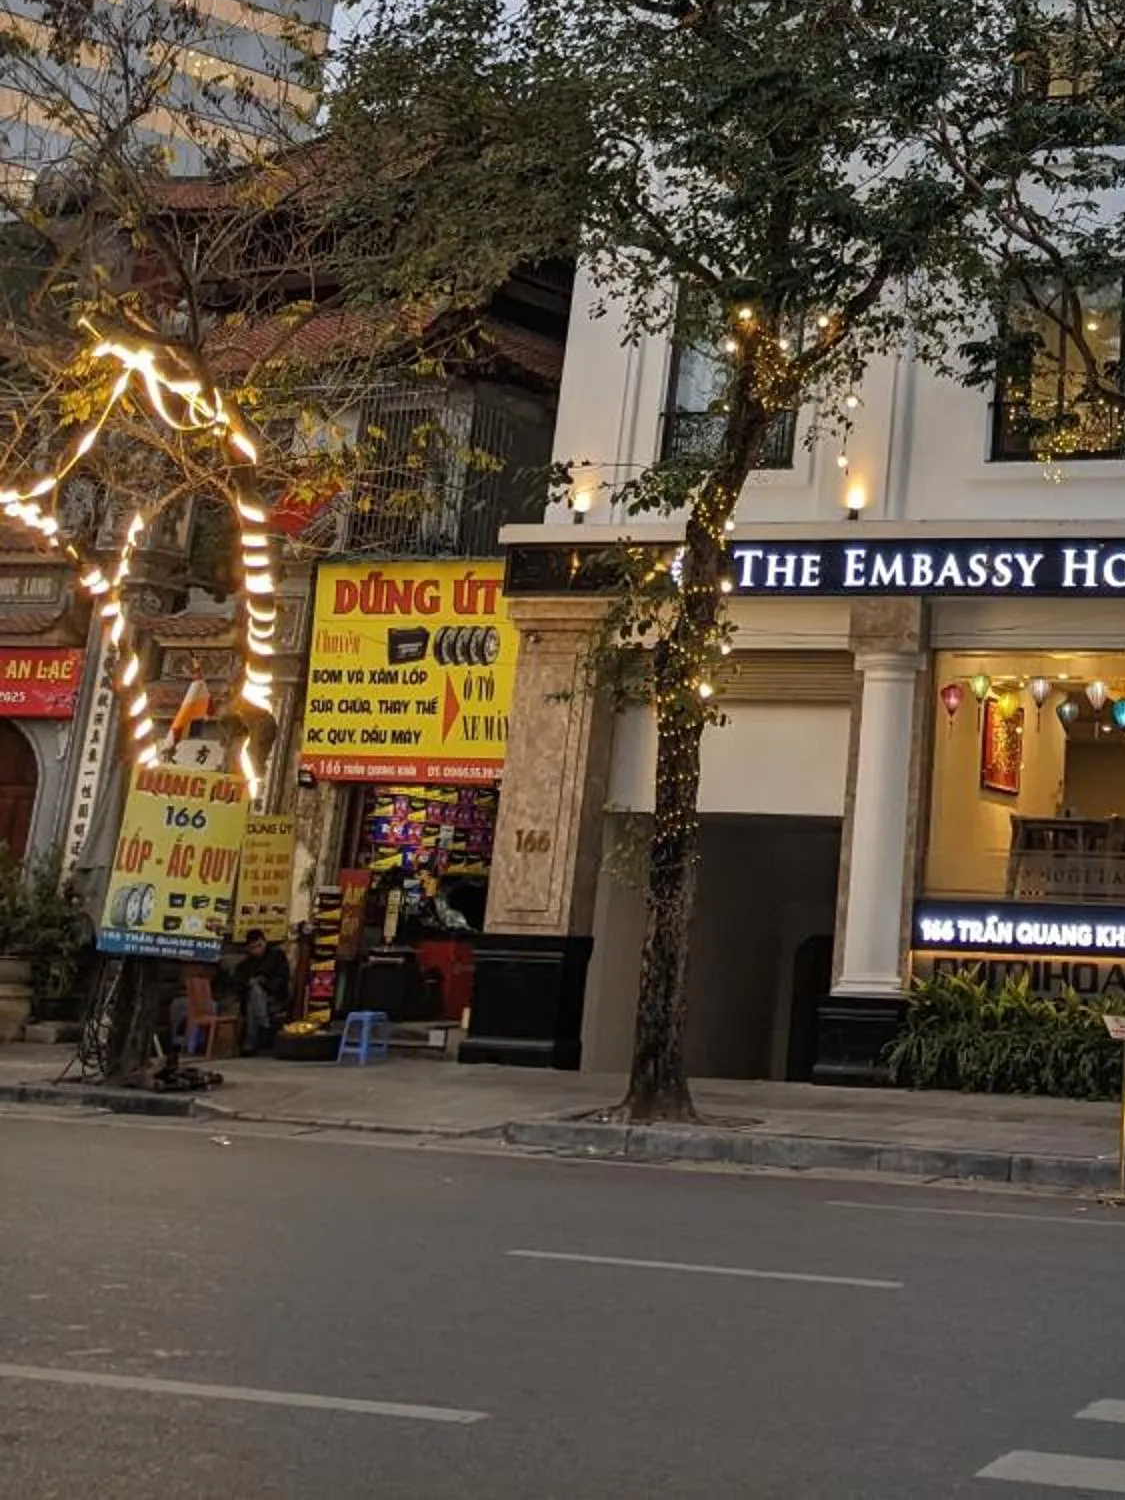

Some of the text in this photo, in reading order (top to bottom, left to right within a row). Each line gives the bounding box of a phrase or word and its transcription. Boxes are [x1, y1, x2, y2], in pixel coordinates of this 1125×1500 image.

[733, 549, 821, 588] THE
[843, 547, 1044, 588] EMBASSY
[453, 570, 504, 615] ÚT
[6, 659, 32, 679] AN
[320, 760, 341, 775] 166
[166, 805, 207, 829] 166
[515, 829, 551, 853] 166
[1015, 920, 1093, 949] QUANG
